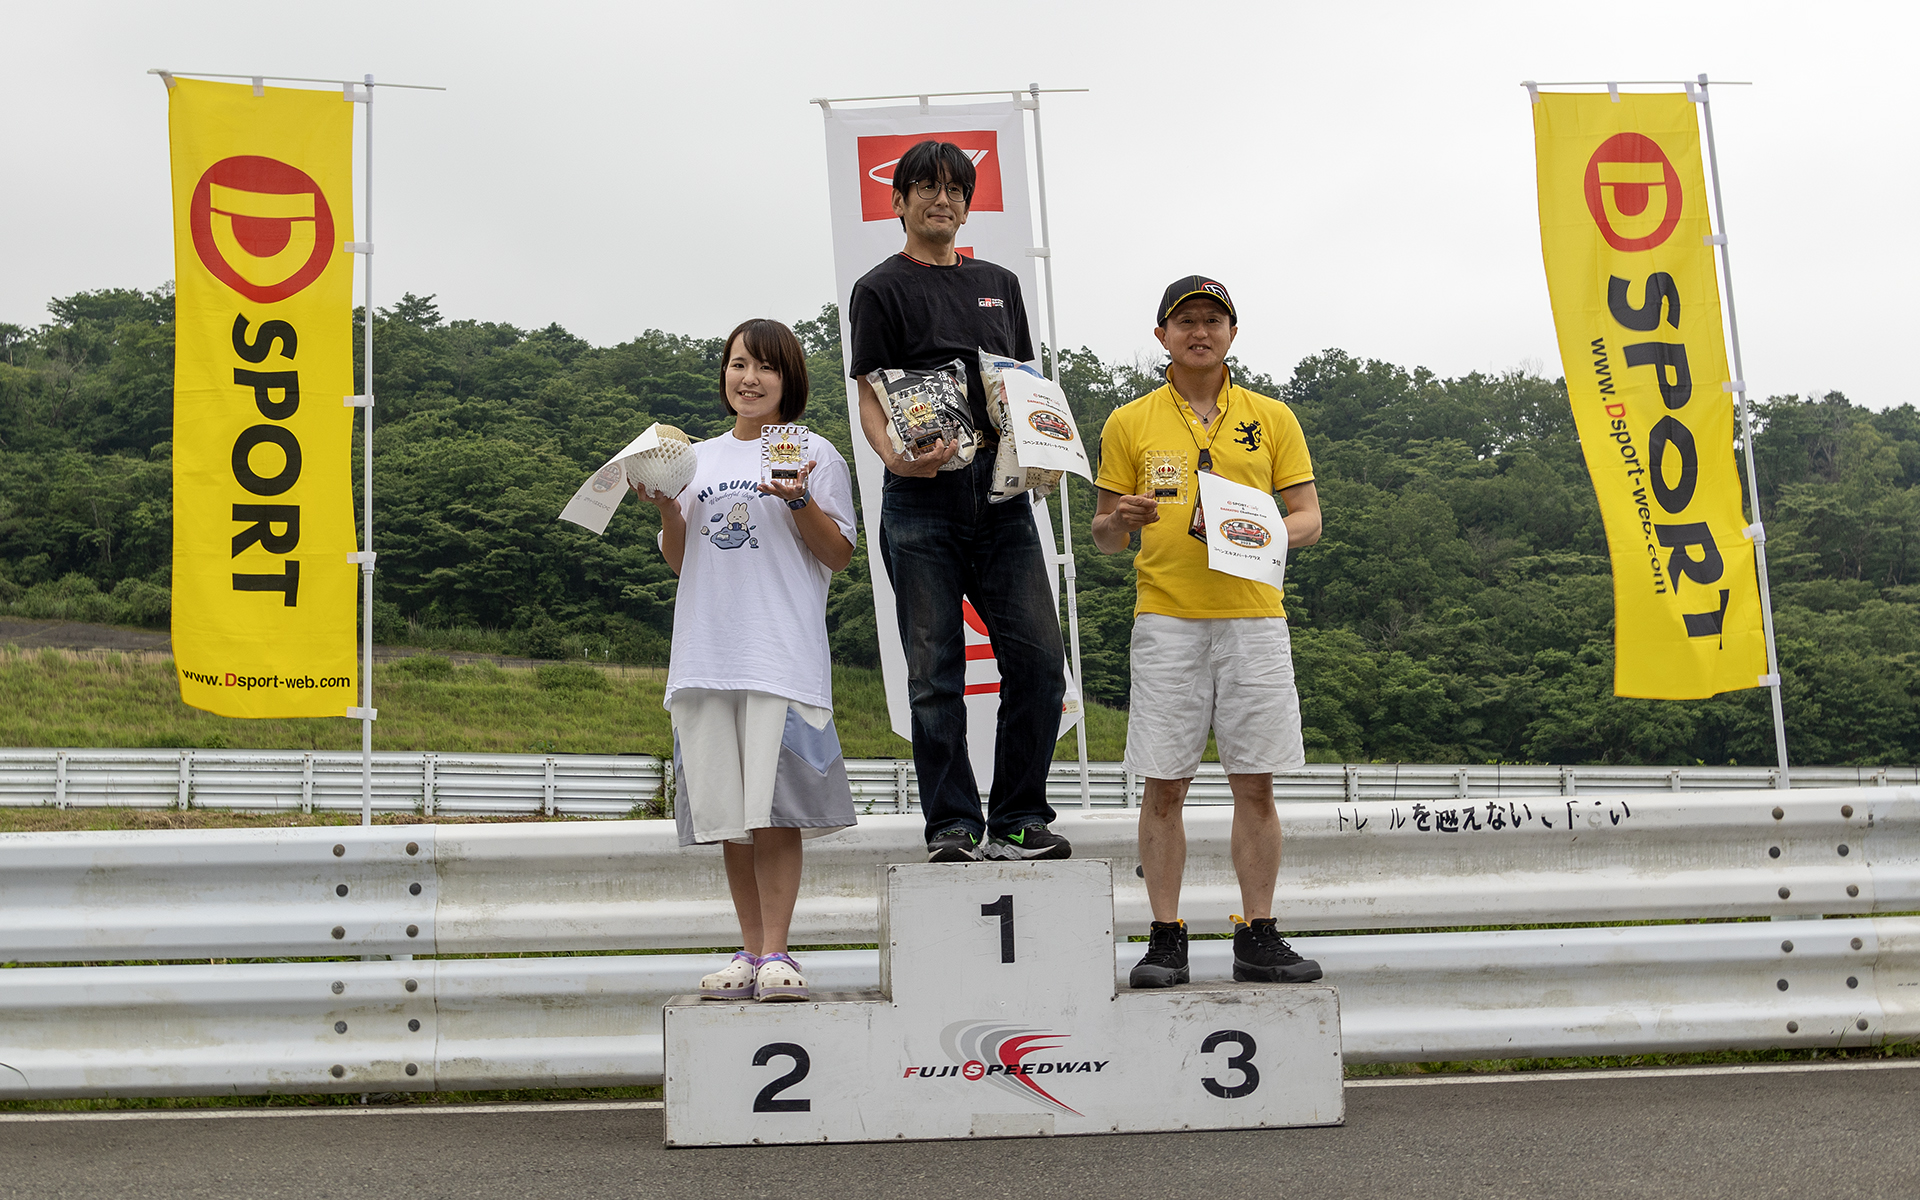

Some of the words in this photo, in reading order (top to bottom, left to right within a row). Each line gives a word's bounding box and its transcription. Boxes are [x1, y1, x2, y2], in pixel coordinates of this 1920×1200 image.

[231, 311, 303, 608] SPORT
[697, 486, 714, 502] HI
[1607, 271, 1729, 650] SPORT
[182, 669, 351, 691] www.Dsport-web.com
[980, 894, 1016, 964] 1
[751, 1041, 812, 1113] 2
[903, 1066, 958, 1079] FUJI
[963, 1060, 1110, 1080] SPEEDWAY
[1200, 1029, 1261, 1099] 3
